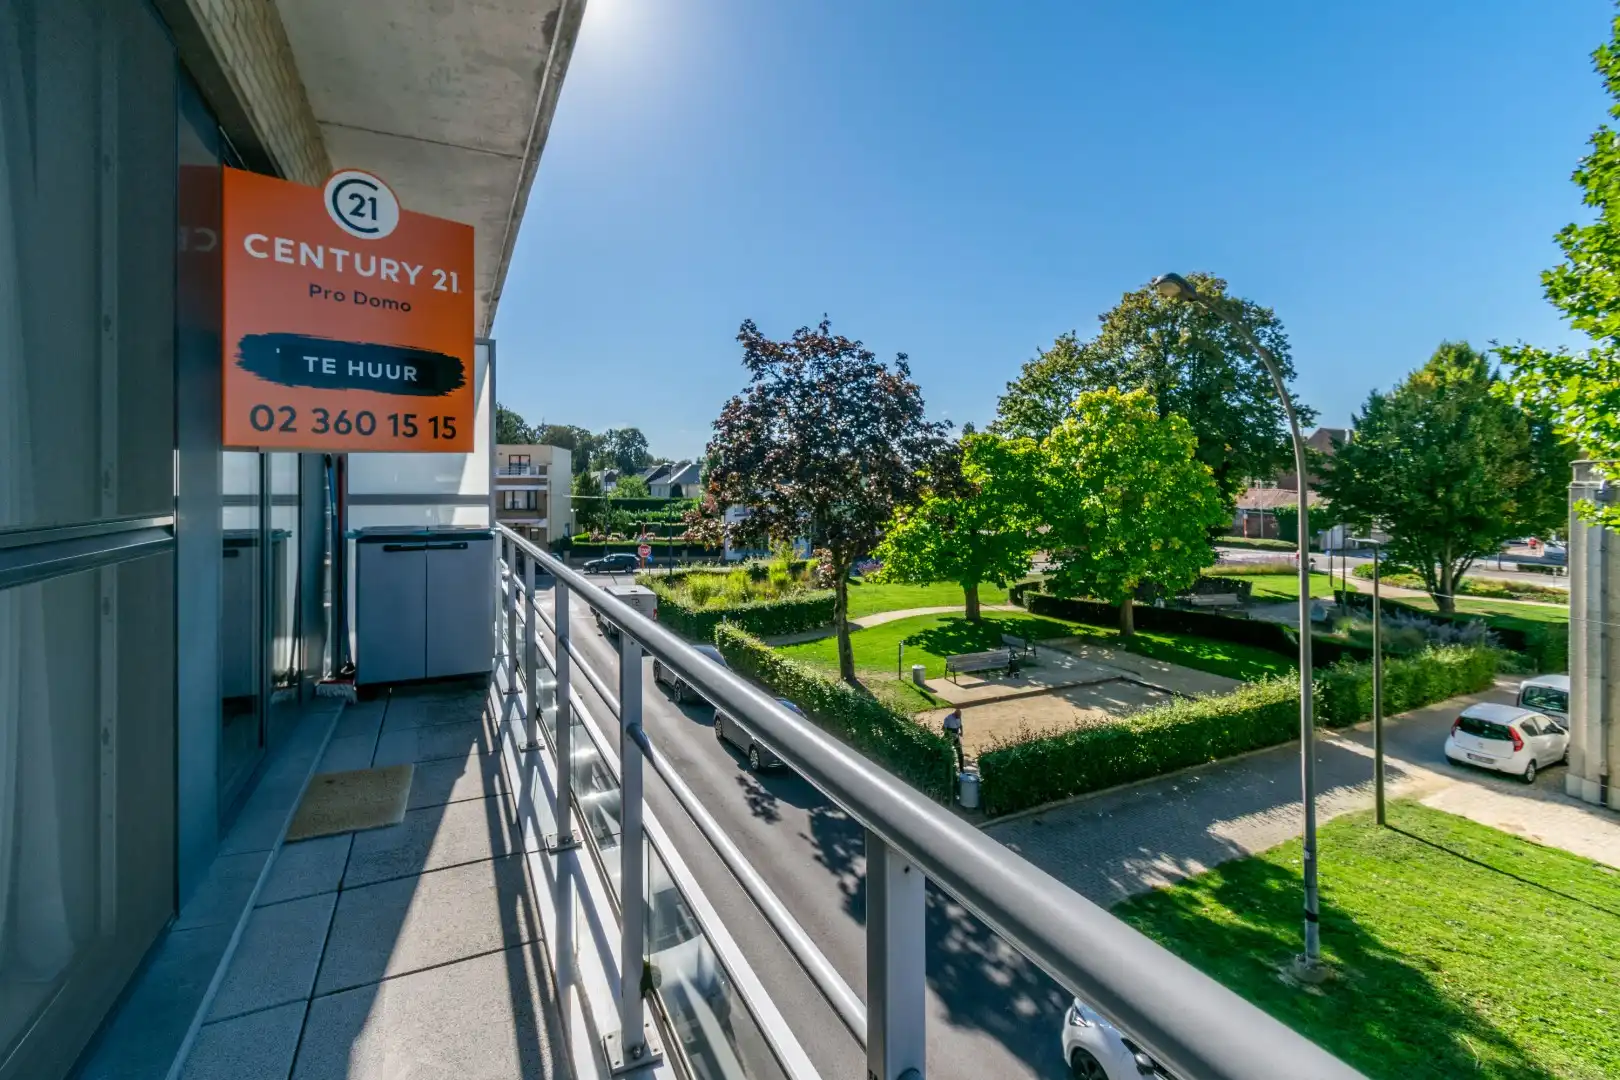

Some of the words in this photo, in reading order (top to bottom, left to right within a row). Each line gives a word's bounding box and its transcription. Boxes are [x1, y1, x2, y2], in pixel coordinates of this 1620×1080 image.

[244, 233, 423, 285] CENTURY
[432, 268, 460, 293] 21
[309, 283, 346, 302] Pro
[353, 290, 412, 312] Domo
[303, 356, 337, 375] TE
[347, 360, 417, 382] HUUR
[249, 404, 297, 432] 02
[311, 408, 377, 436] 360
[387, 413, 418, 438] 15
[428, 415, 457, 440] 15
